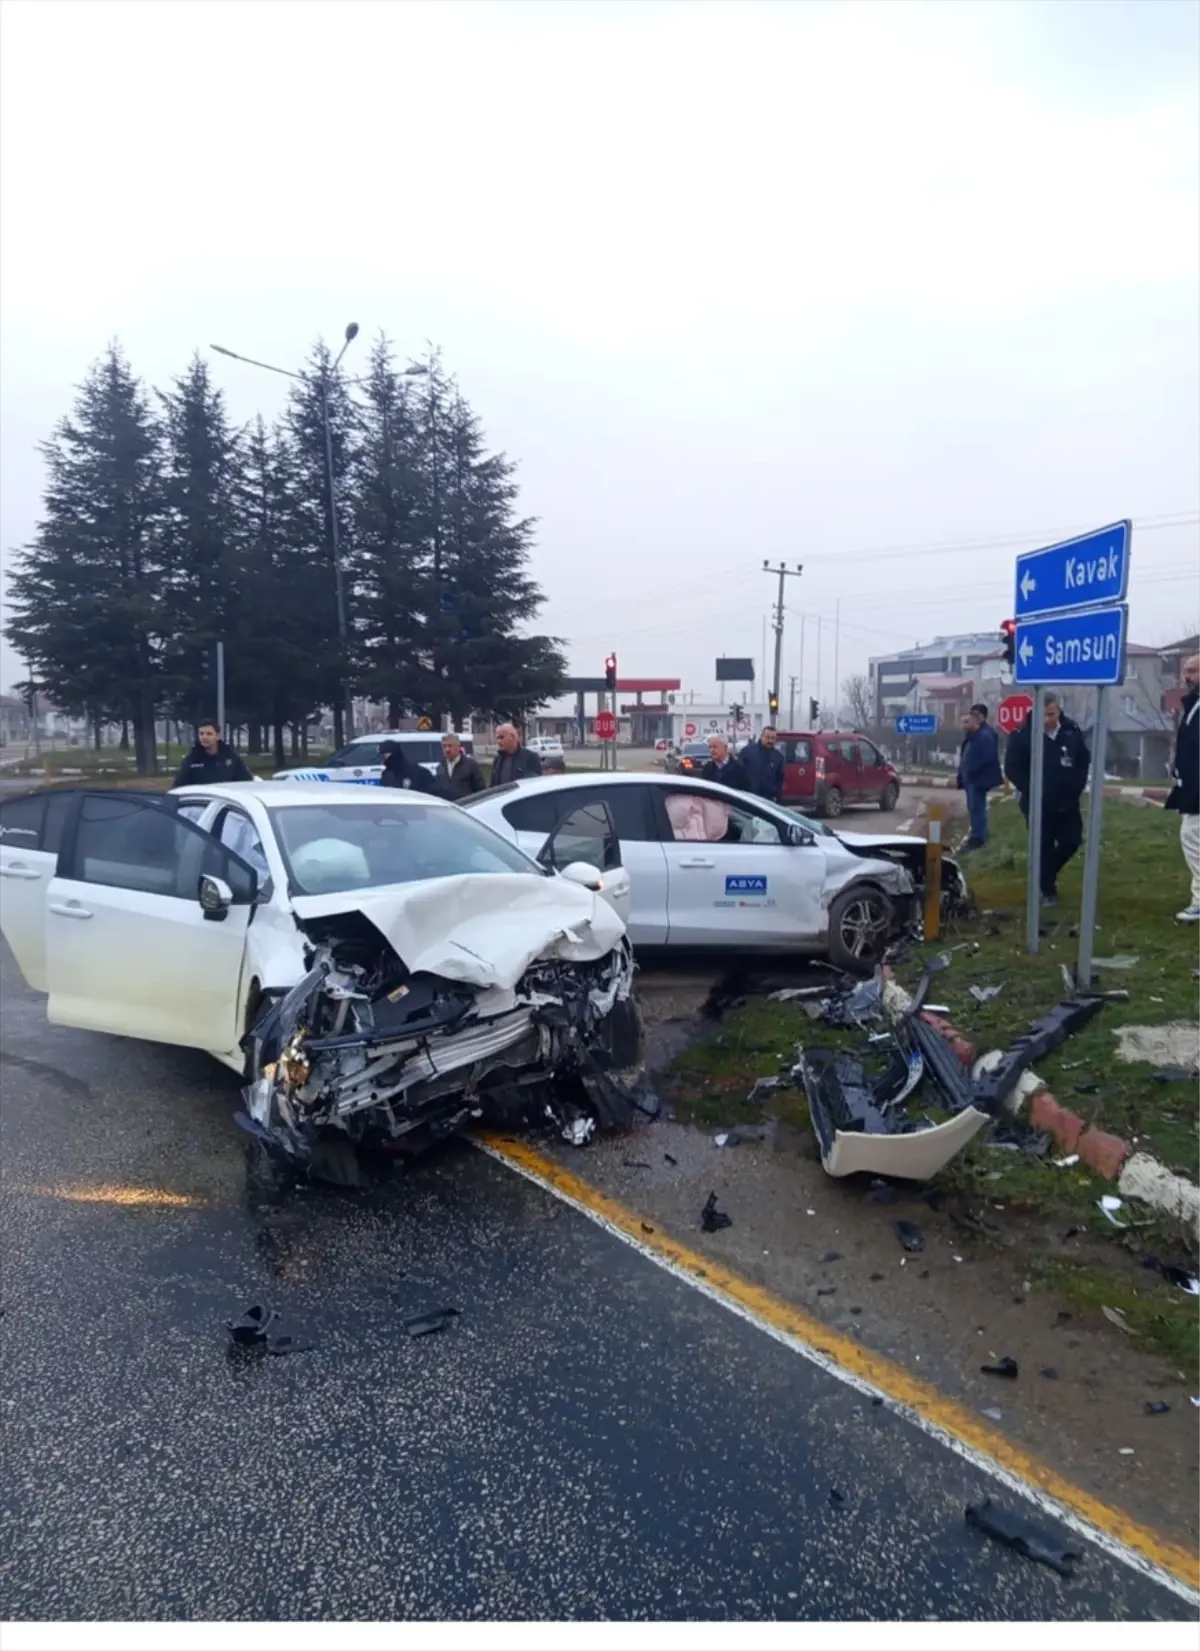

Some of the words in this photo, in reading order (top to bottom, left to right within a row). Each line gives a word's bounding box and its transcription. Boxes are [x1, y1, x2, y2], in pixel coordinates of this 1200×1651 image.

[1065, 546, 1119, 589] Kavak
[1045, 633, 1116, 666] Samsun
[595, 719, 616, 731] DUR
